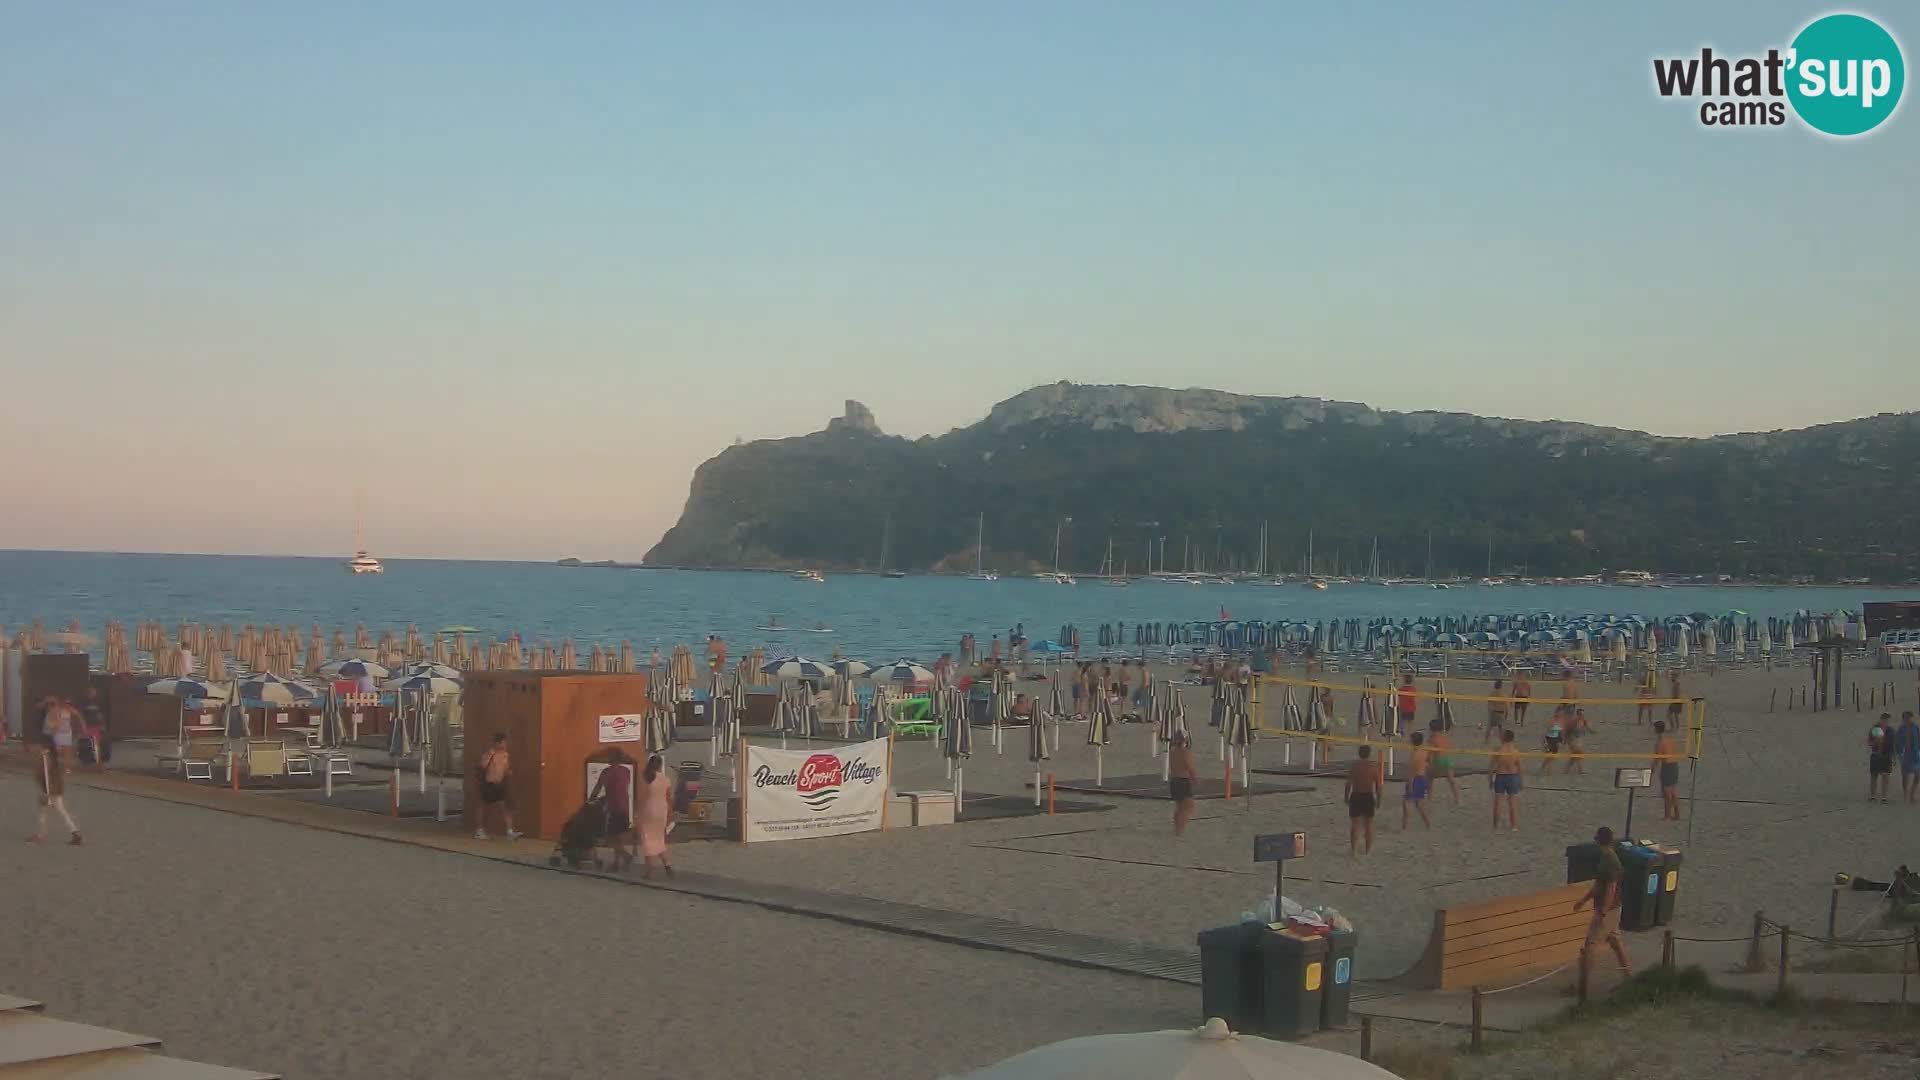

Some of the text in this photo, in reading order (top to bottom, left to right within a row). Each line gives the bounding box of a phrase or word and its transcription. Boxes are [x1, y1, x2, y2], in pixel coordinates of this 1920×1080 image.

[753, 756, 882, 789] Beach Sport Village
